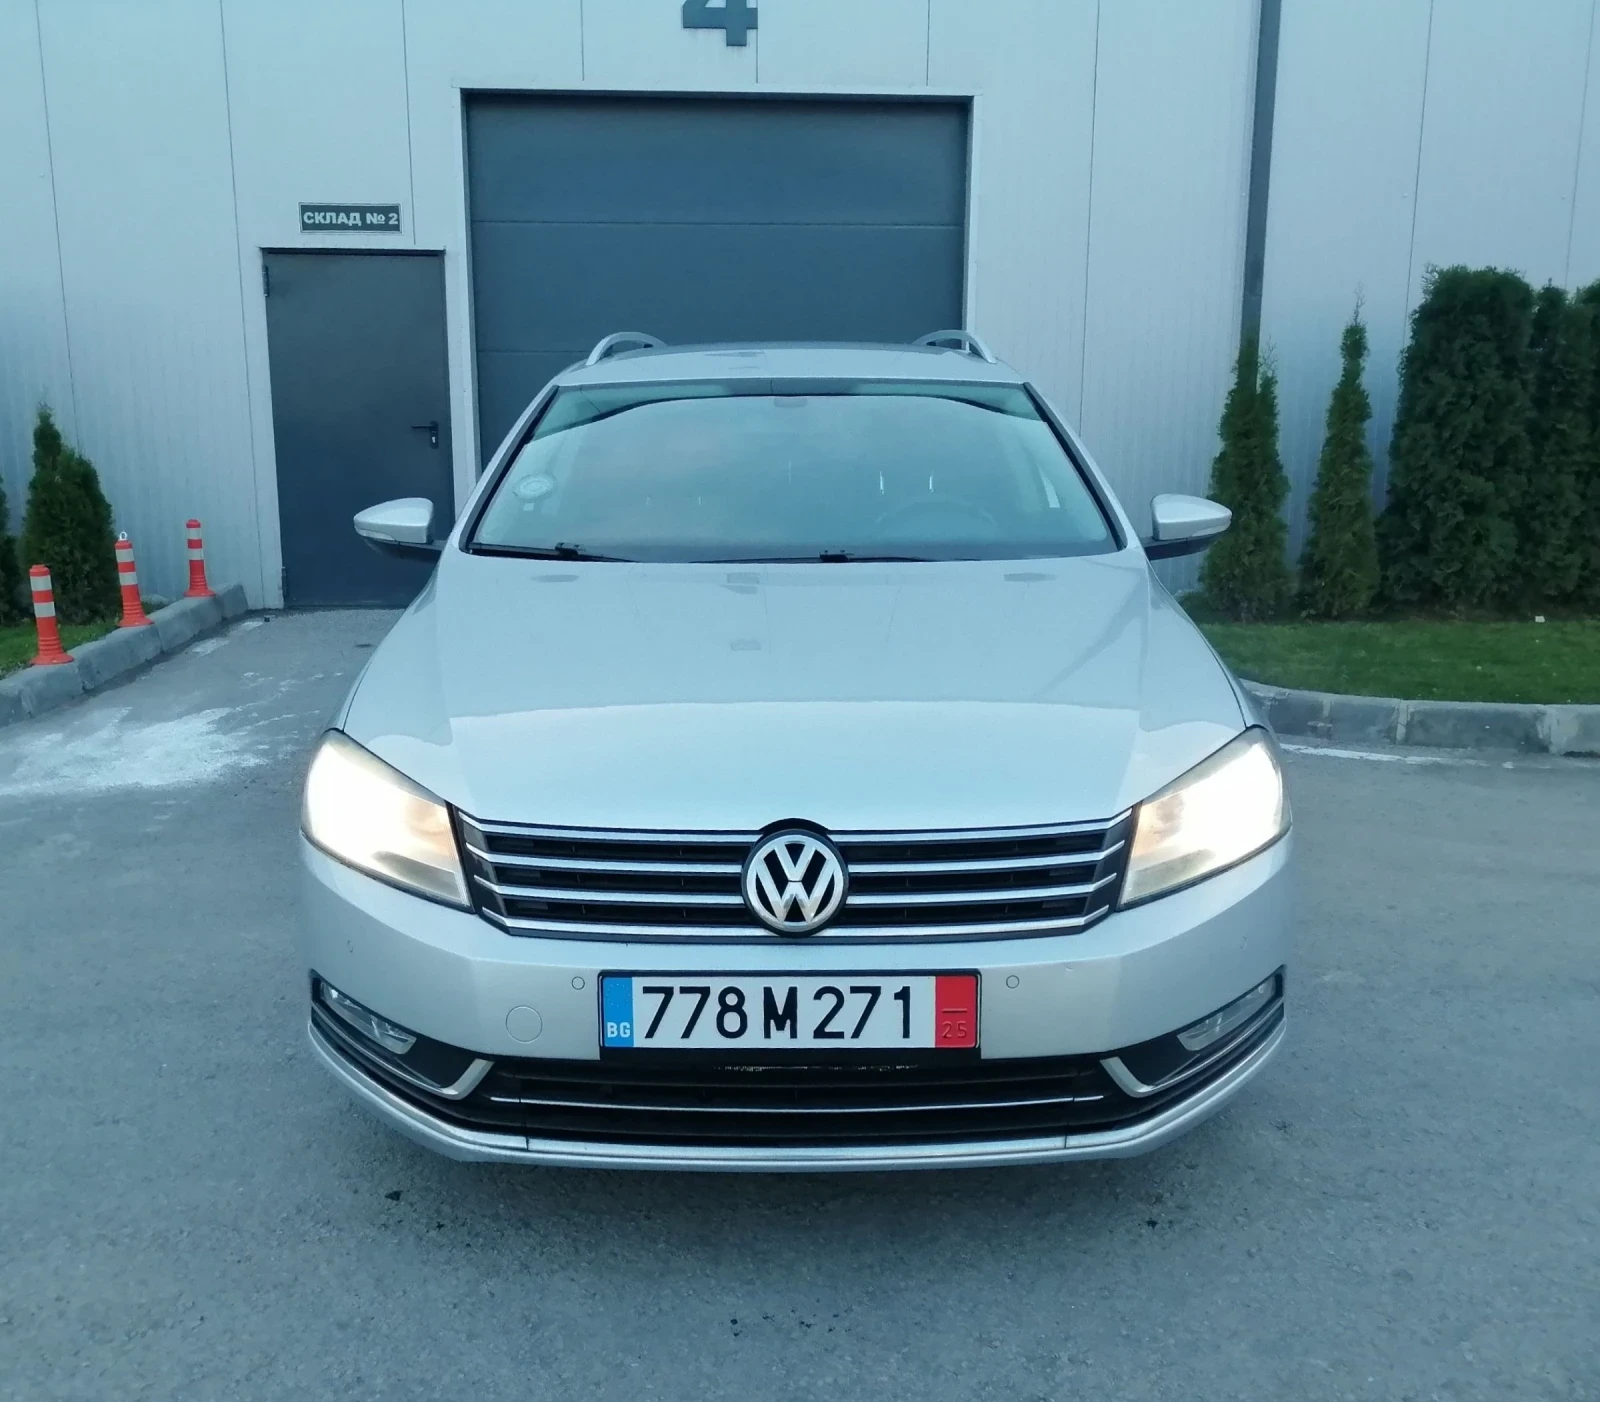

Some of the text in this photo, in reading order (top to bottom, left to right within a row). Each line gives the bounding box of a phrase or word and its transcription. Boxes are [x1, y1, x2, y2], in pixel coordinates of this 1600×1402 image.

[303, 212, 362, 226] СКЛАД
[388, 213, 399, 225] 2
[606, 1021, 631, 1038] BG
[941, 1020, 967, 1039] 25
